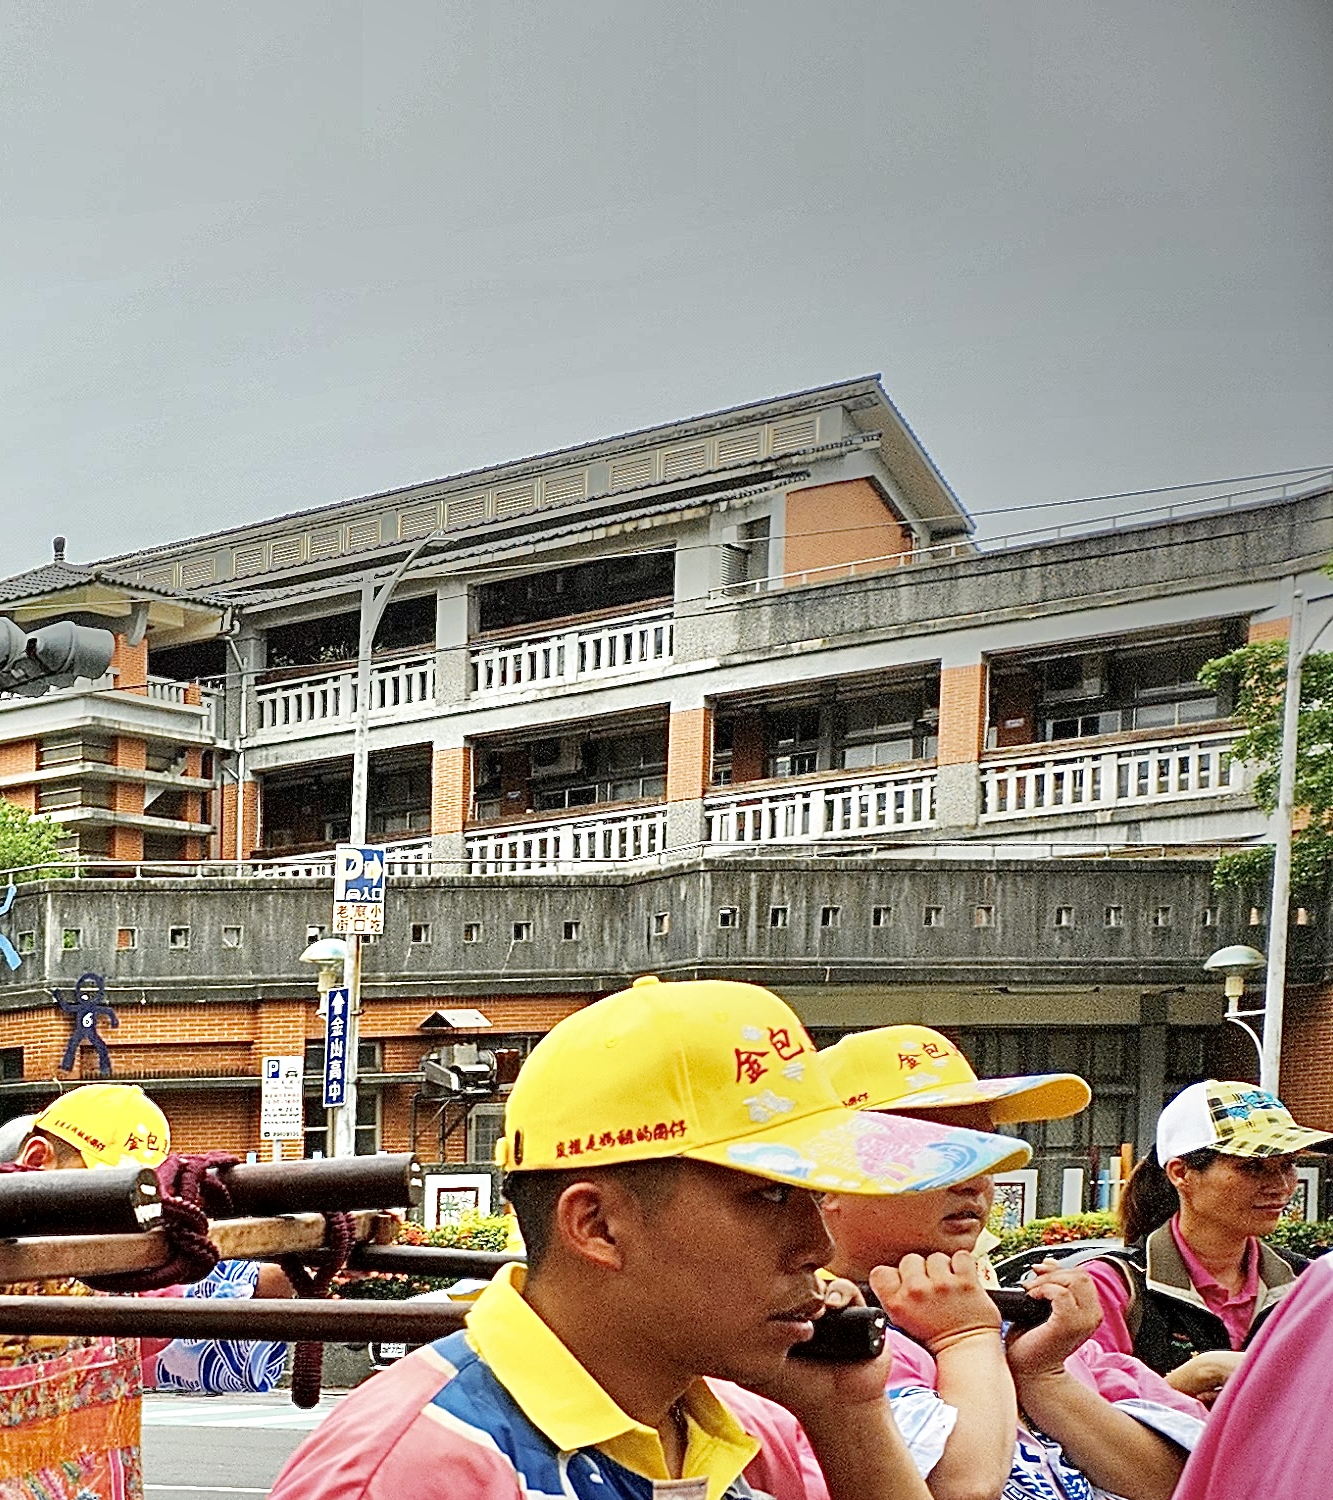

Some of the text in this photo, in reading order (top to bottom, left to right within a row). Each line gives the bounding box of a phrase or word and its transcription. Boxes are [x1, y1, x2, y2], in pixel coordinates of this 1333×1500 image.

[81, 1012, 94, 1028] 6
[329, 1016, 346, 1102] 金山高中
[734, 1023, 817, 1085] 金包
